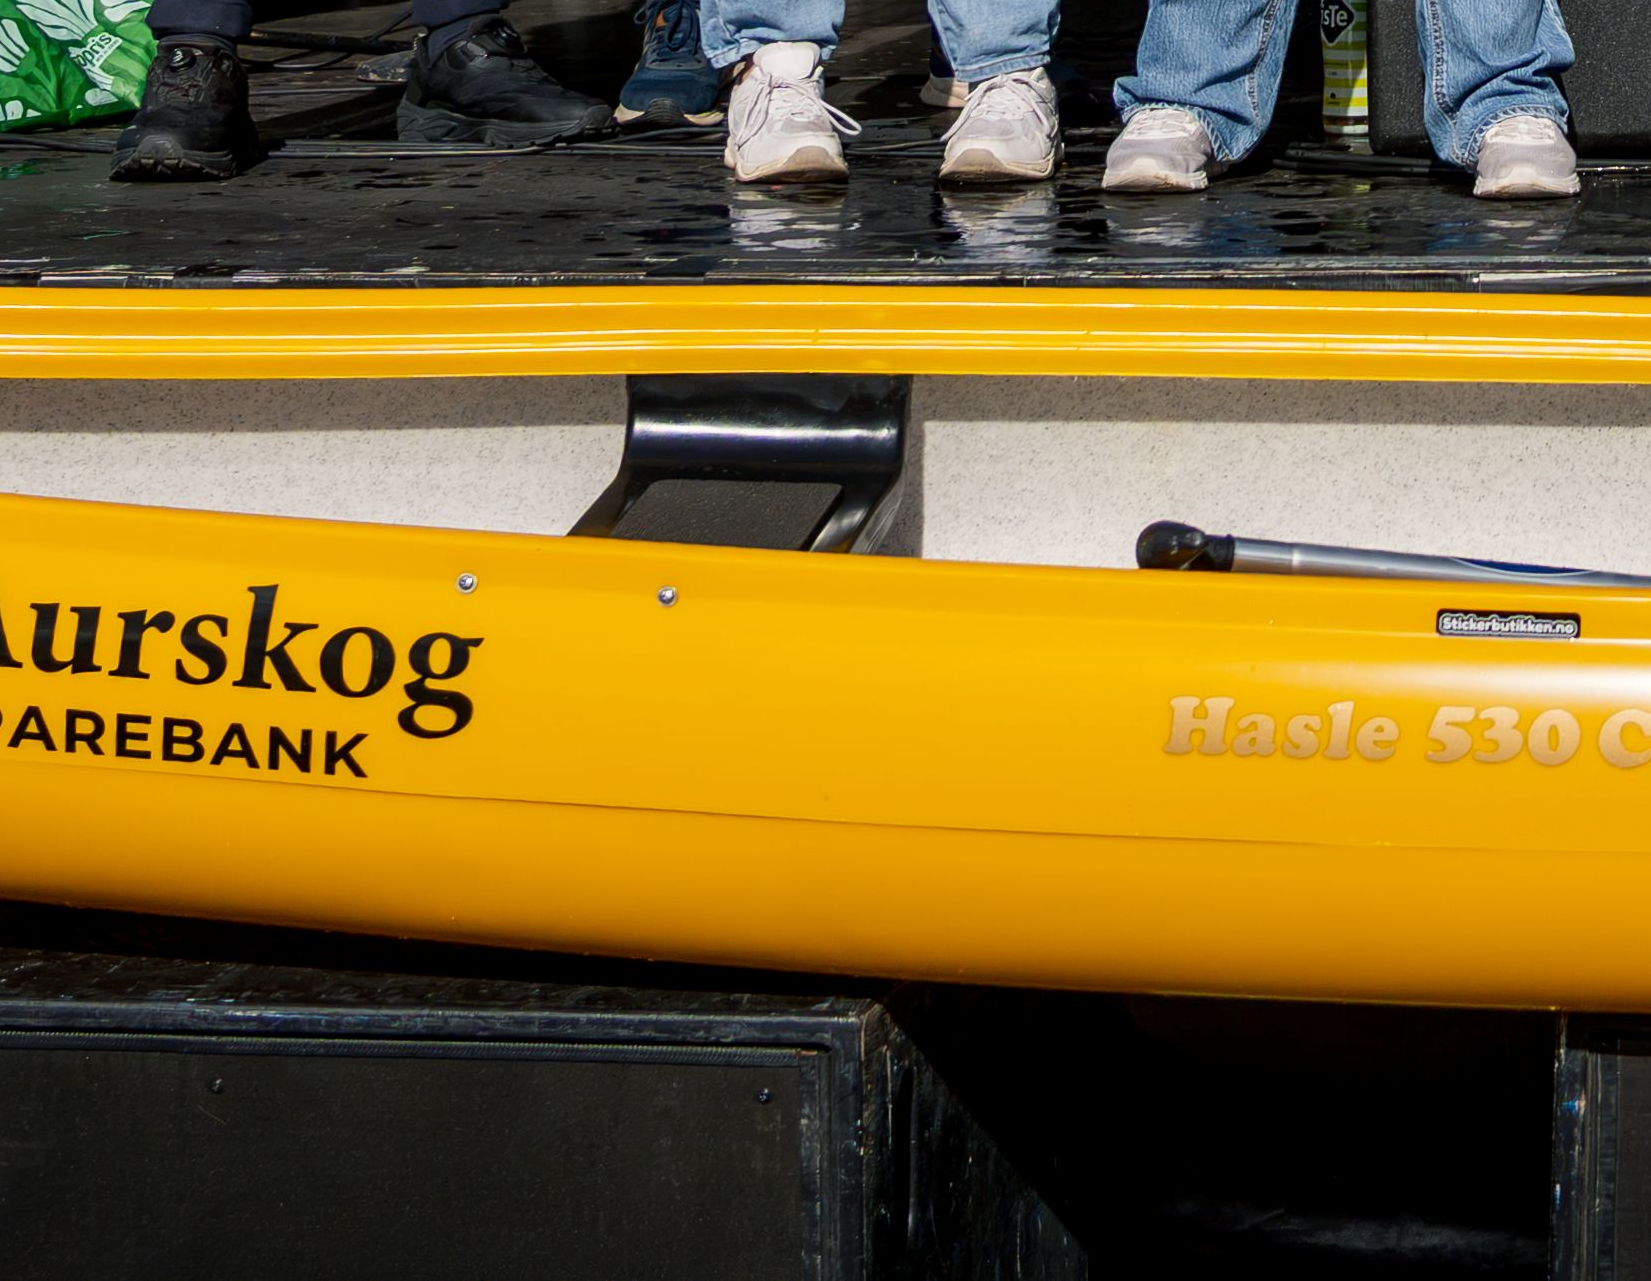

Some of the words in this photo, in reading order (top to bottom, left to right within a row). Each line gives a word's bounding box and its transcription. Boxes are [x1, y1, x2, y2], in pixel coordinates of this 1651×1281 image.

[72, 33, 112, 68] opris
[1442, 616, 1575, 635] Stickerbutikken.no
[1162, 696, 1398, 764] Hasle
[1423, 705, 1580, 768] 530
